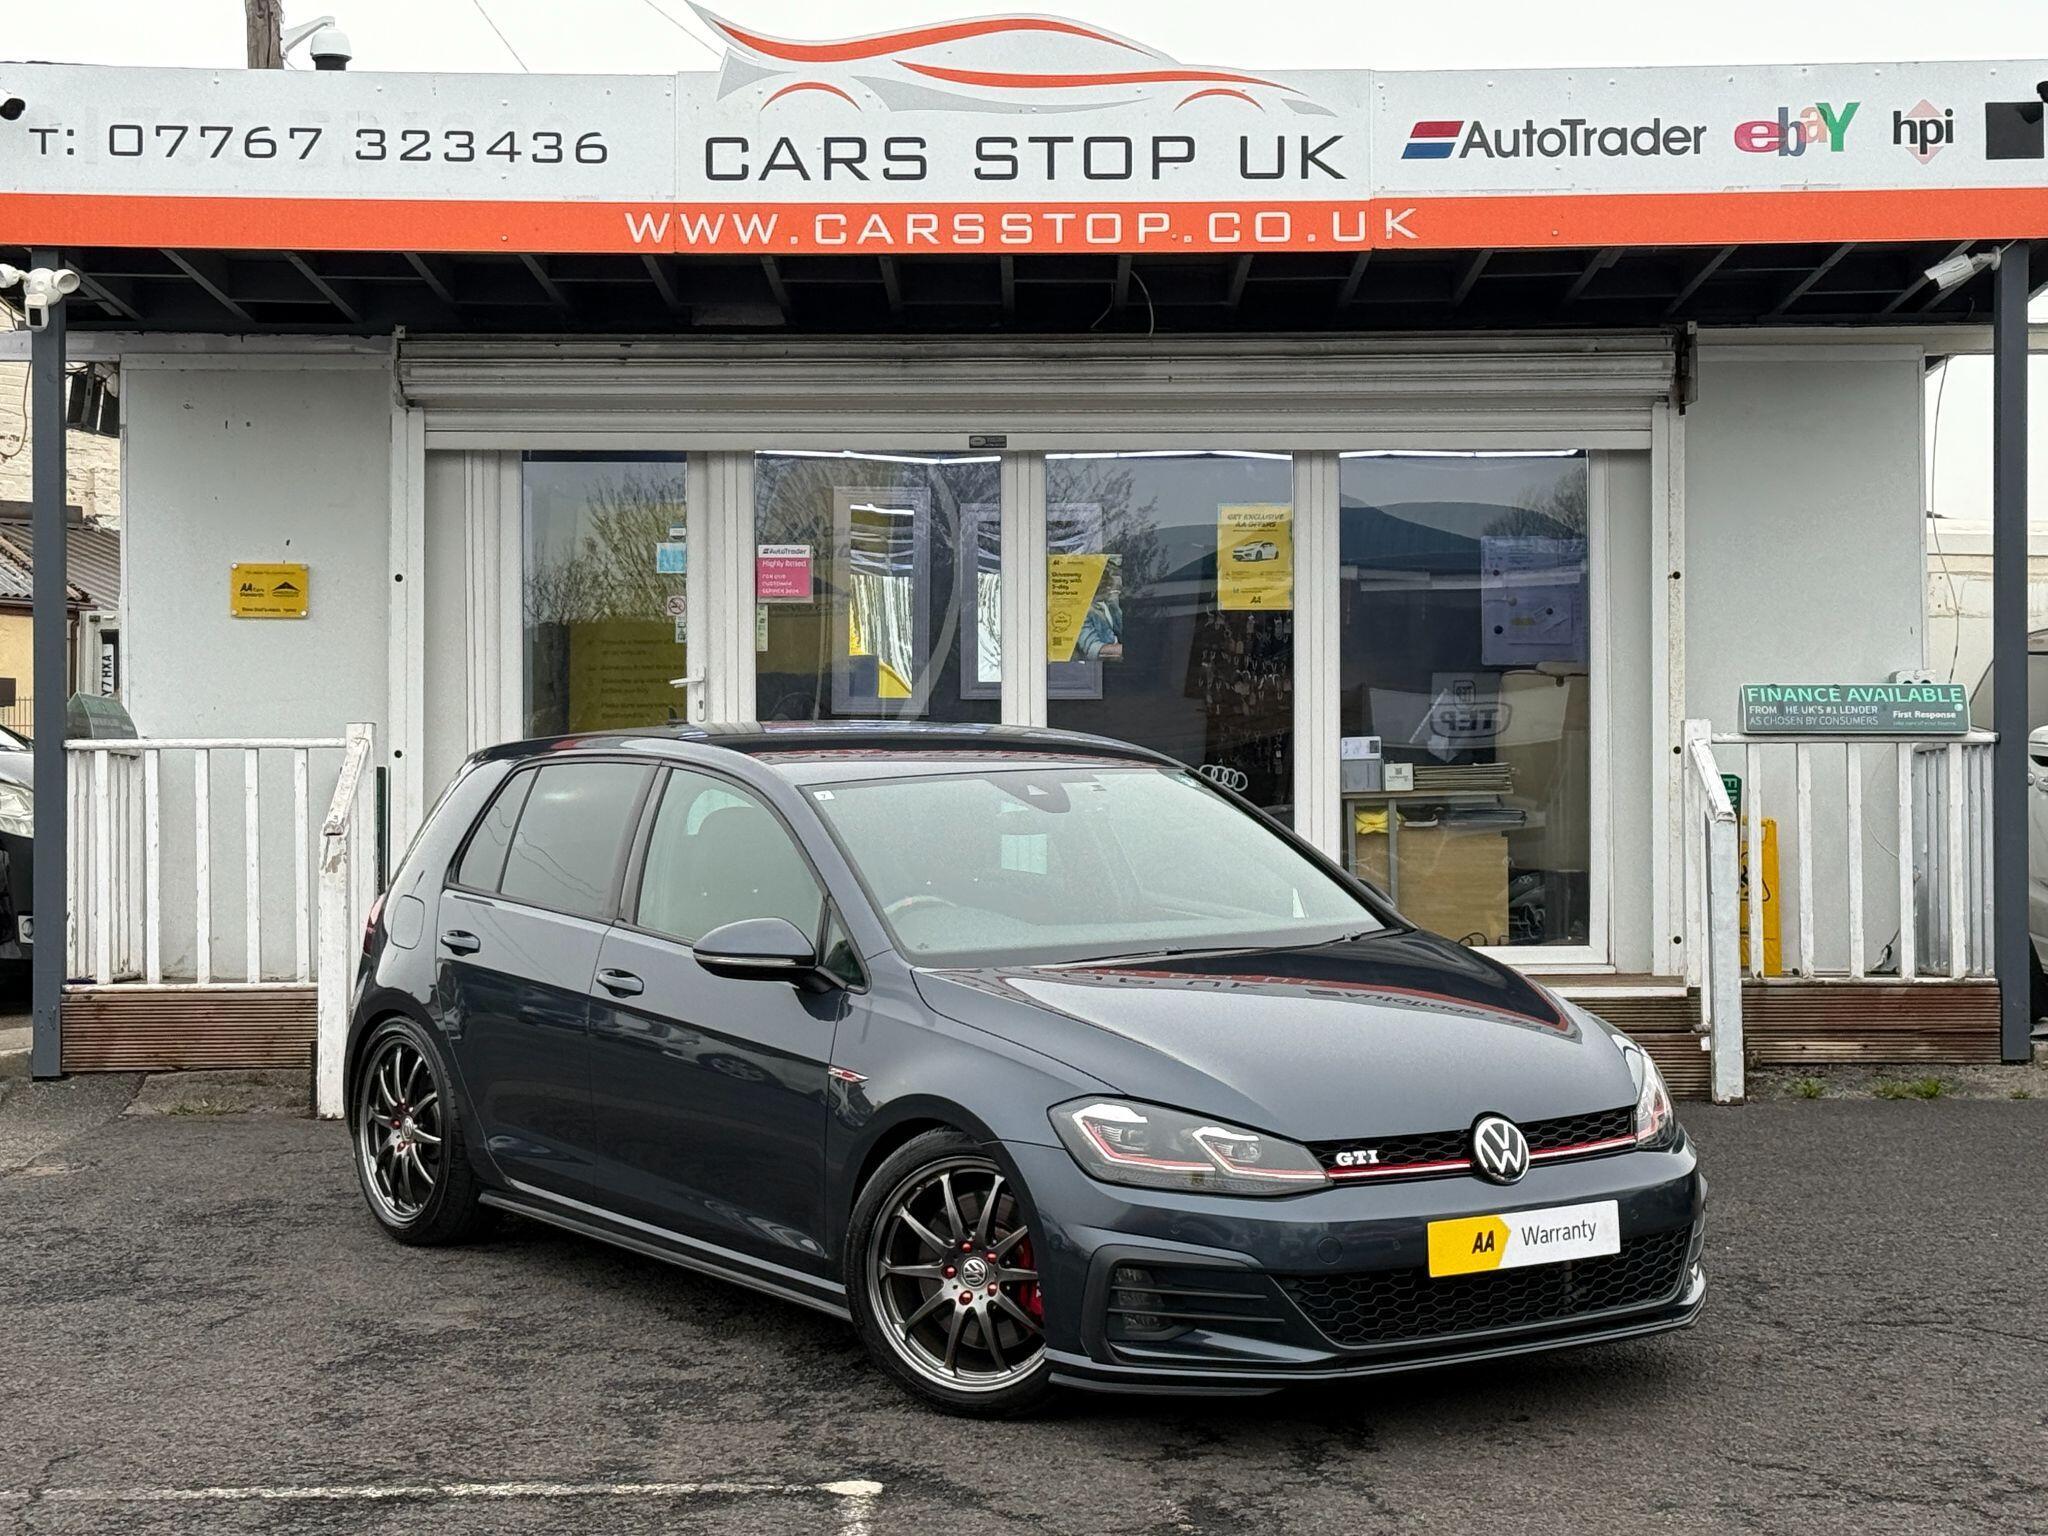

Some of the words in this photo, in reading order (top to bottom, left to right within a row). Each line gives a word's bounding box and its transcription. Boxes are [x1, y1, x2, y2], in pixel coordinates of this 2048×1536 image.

[1459, 117, 1707, 158] AutoTrader
[1892, 108, 1954, 155] hpi
[28, 127, 75, 156] T:
[108, 125, 323, 160] 07767
[354, 128, 609, 165] 323436
[705, 136, 928, 182] CARS
[974, 135, 1196, 181] STOP
[1238, 134, 1347, 180] UK
[1747, 687, 1842, 702] FINANCE
[1846, 687, 1962, 703] AVAILABLE
[1749, 705, 1777, 714] FROM
[1801, 705, 1824, 714] UK'S
[1840, 705, 1878, 714] LENDER
[1750, 716, 1763, 725] AS
[1763, 716, 1804, 726] CHOSEN
[1806, 716, 1817, 725] BY
[1819, 716, 1879, 726] CONSUMERS
[1892, 710, 1912, 718] First
[1914, 710, 1957, 719] Response
[1335, 1149, 1380, 1167] GTI
[1472, 1230, 1495, 1254] AA
[1521, 1219, 1597, 1247] Warranty
